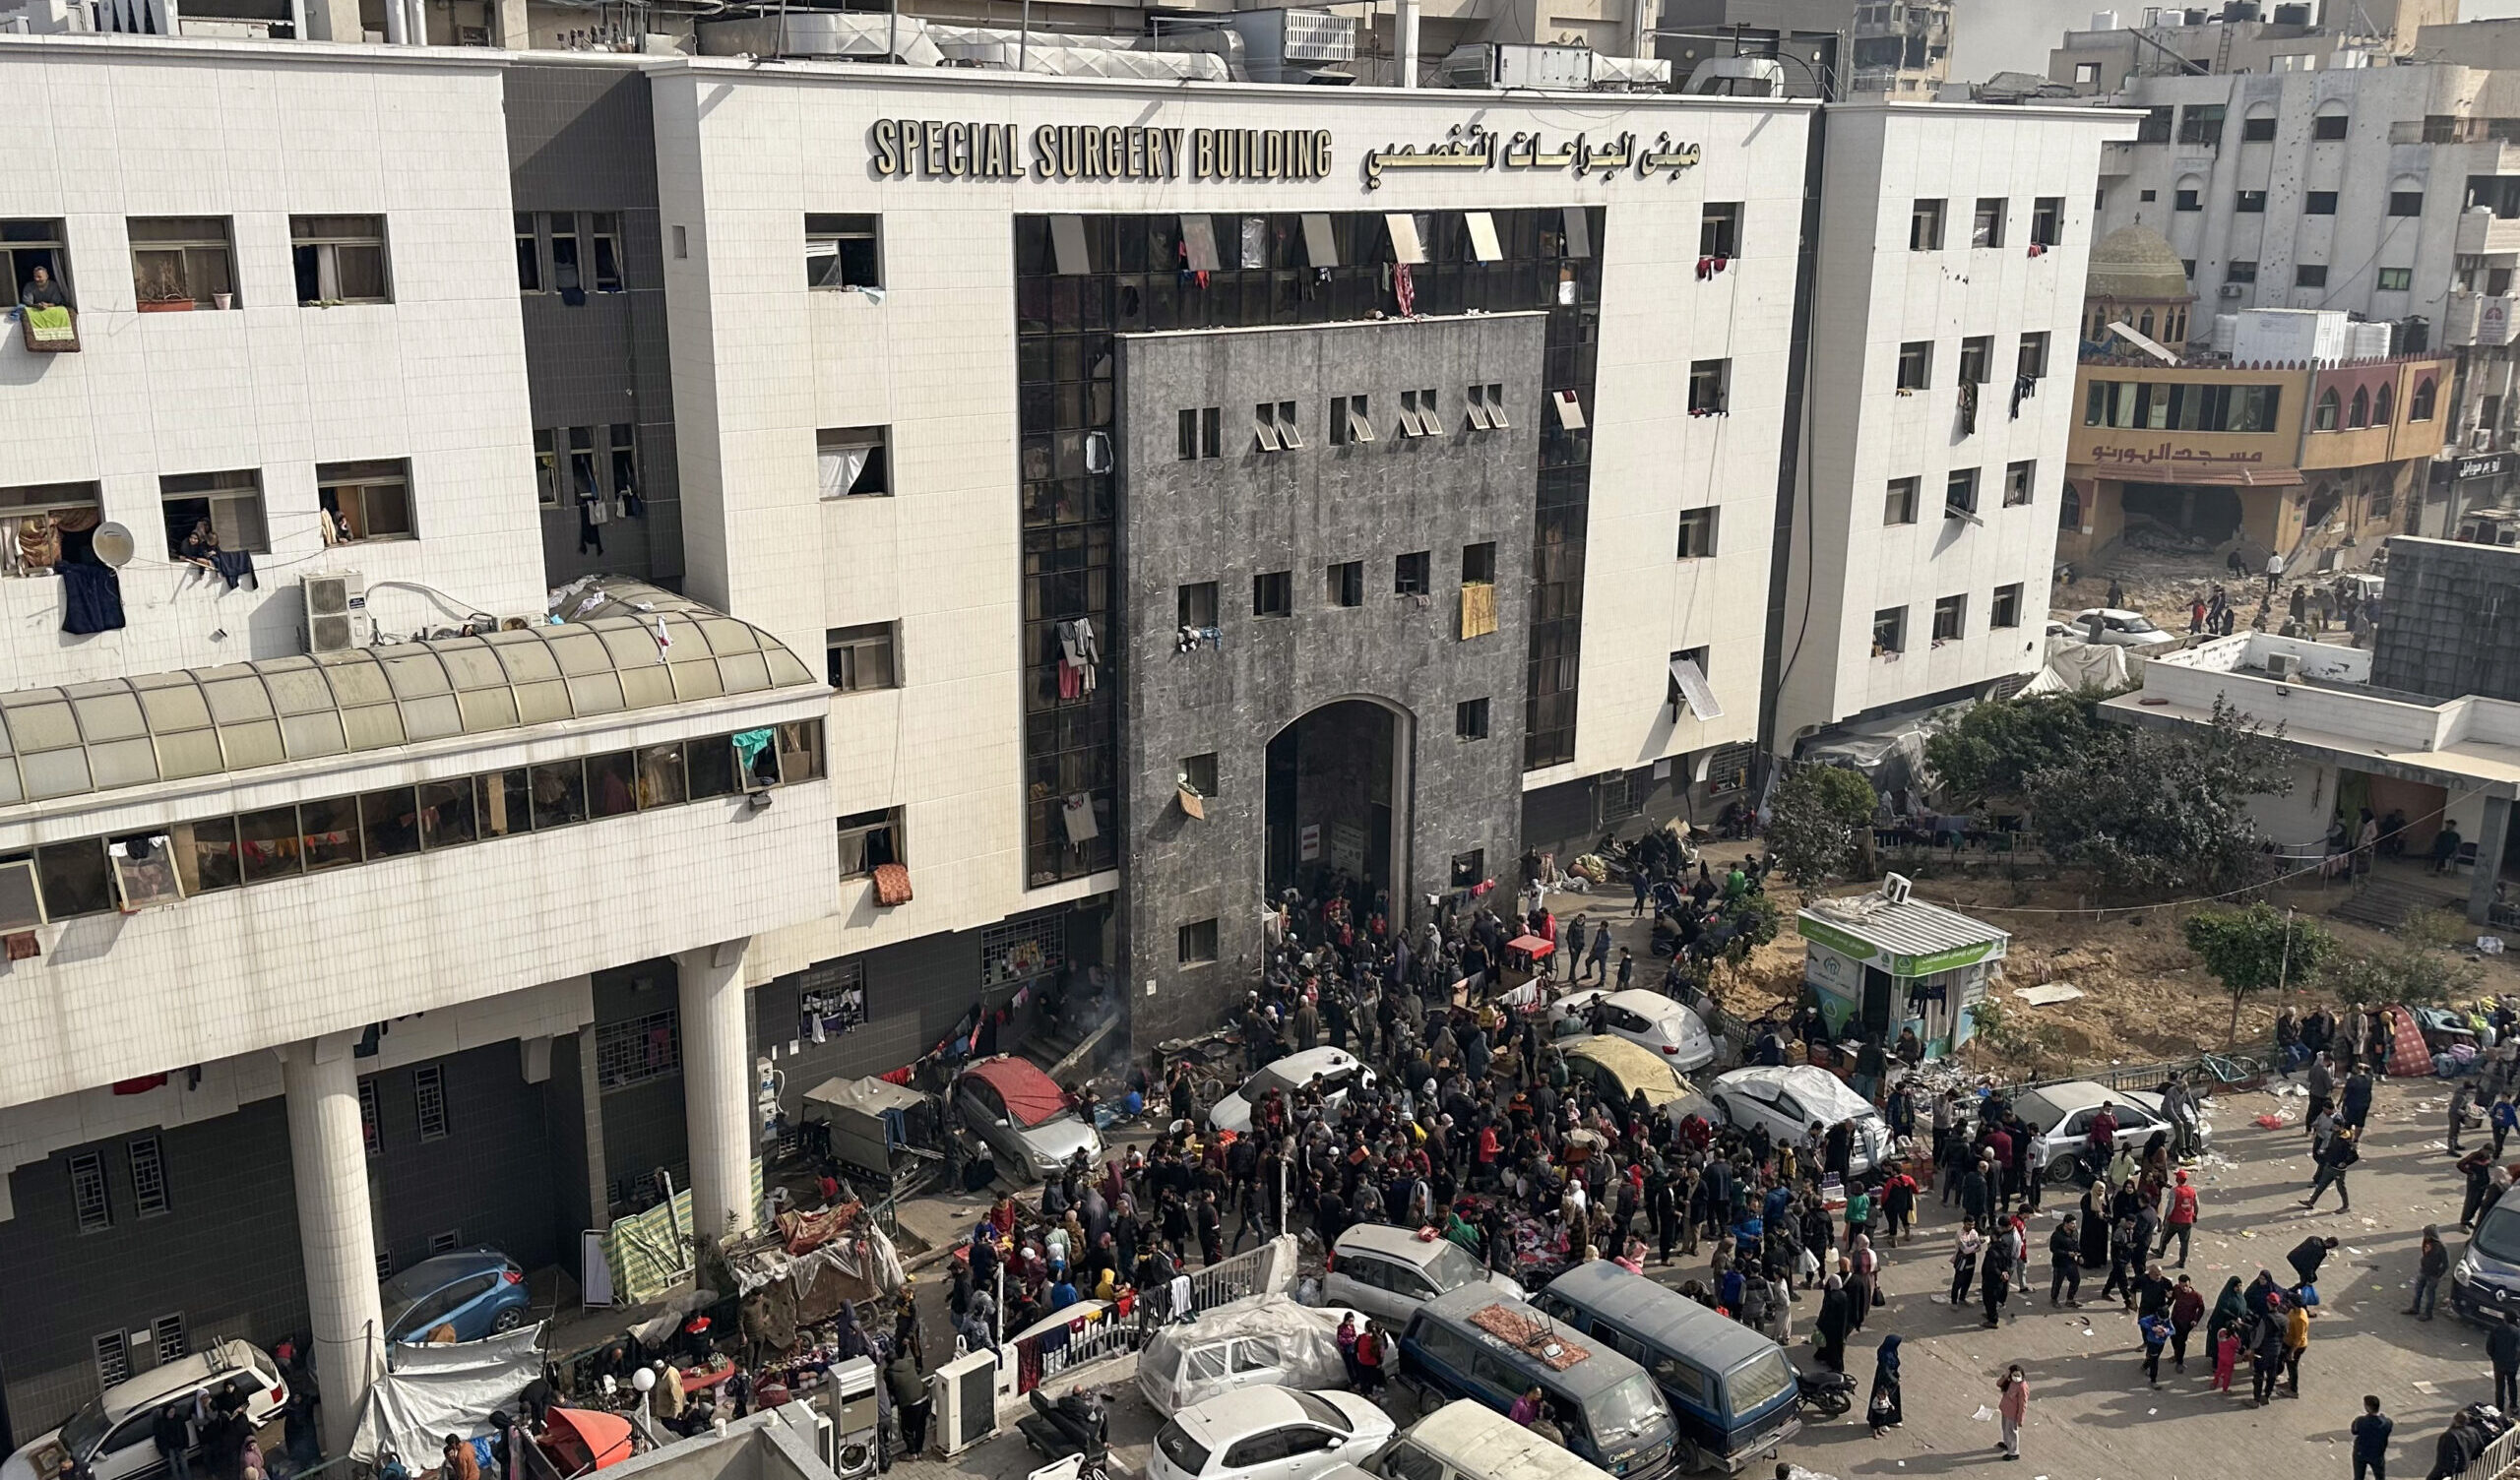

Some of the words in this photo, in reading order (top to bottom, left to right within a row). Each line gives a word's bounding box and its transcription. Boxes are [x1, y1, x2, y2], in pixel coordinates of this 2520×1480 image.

[873, 118, 1026, 178] SPECIAL
[1035, 124, 1185, 179] SURGERY
[1193, 128, 1333, 179] BUILDING
[1505, 130, 1636, 181] الجراحات
[2171, 448, 2263, 466] مسجد
